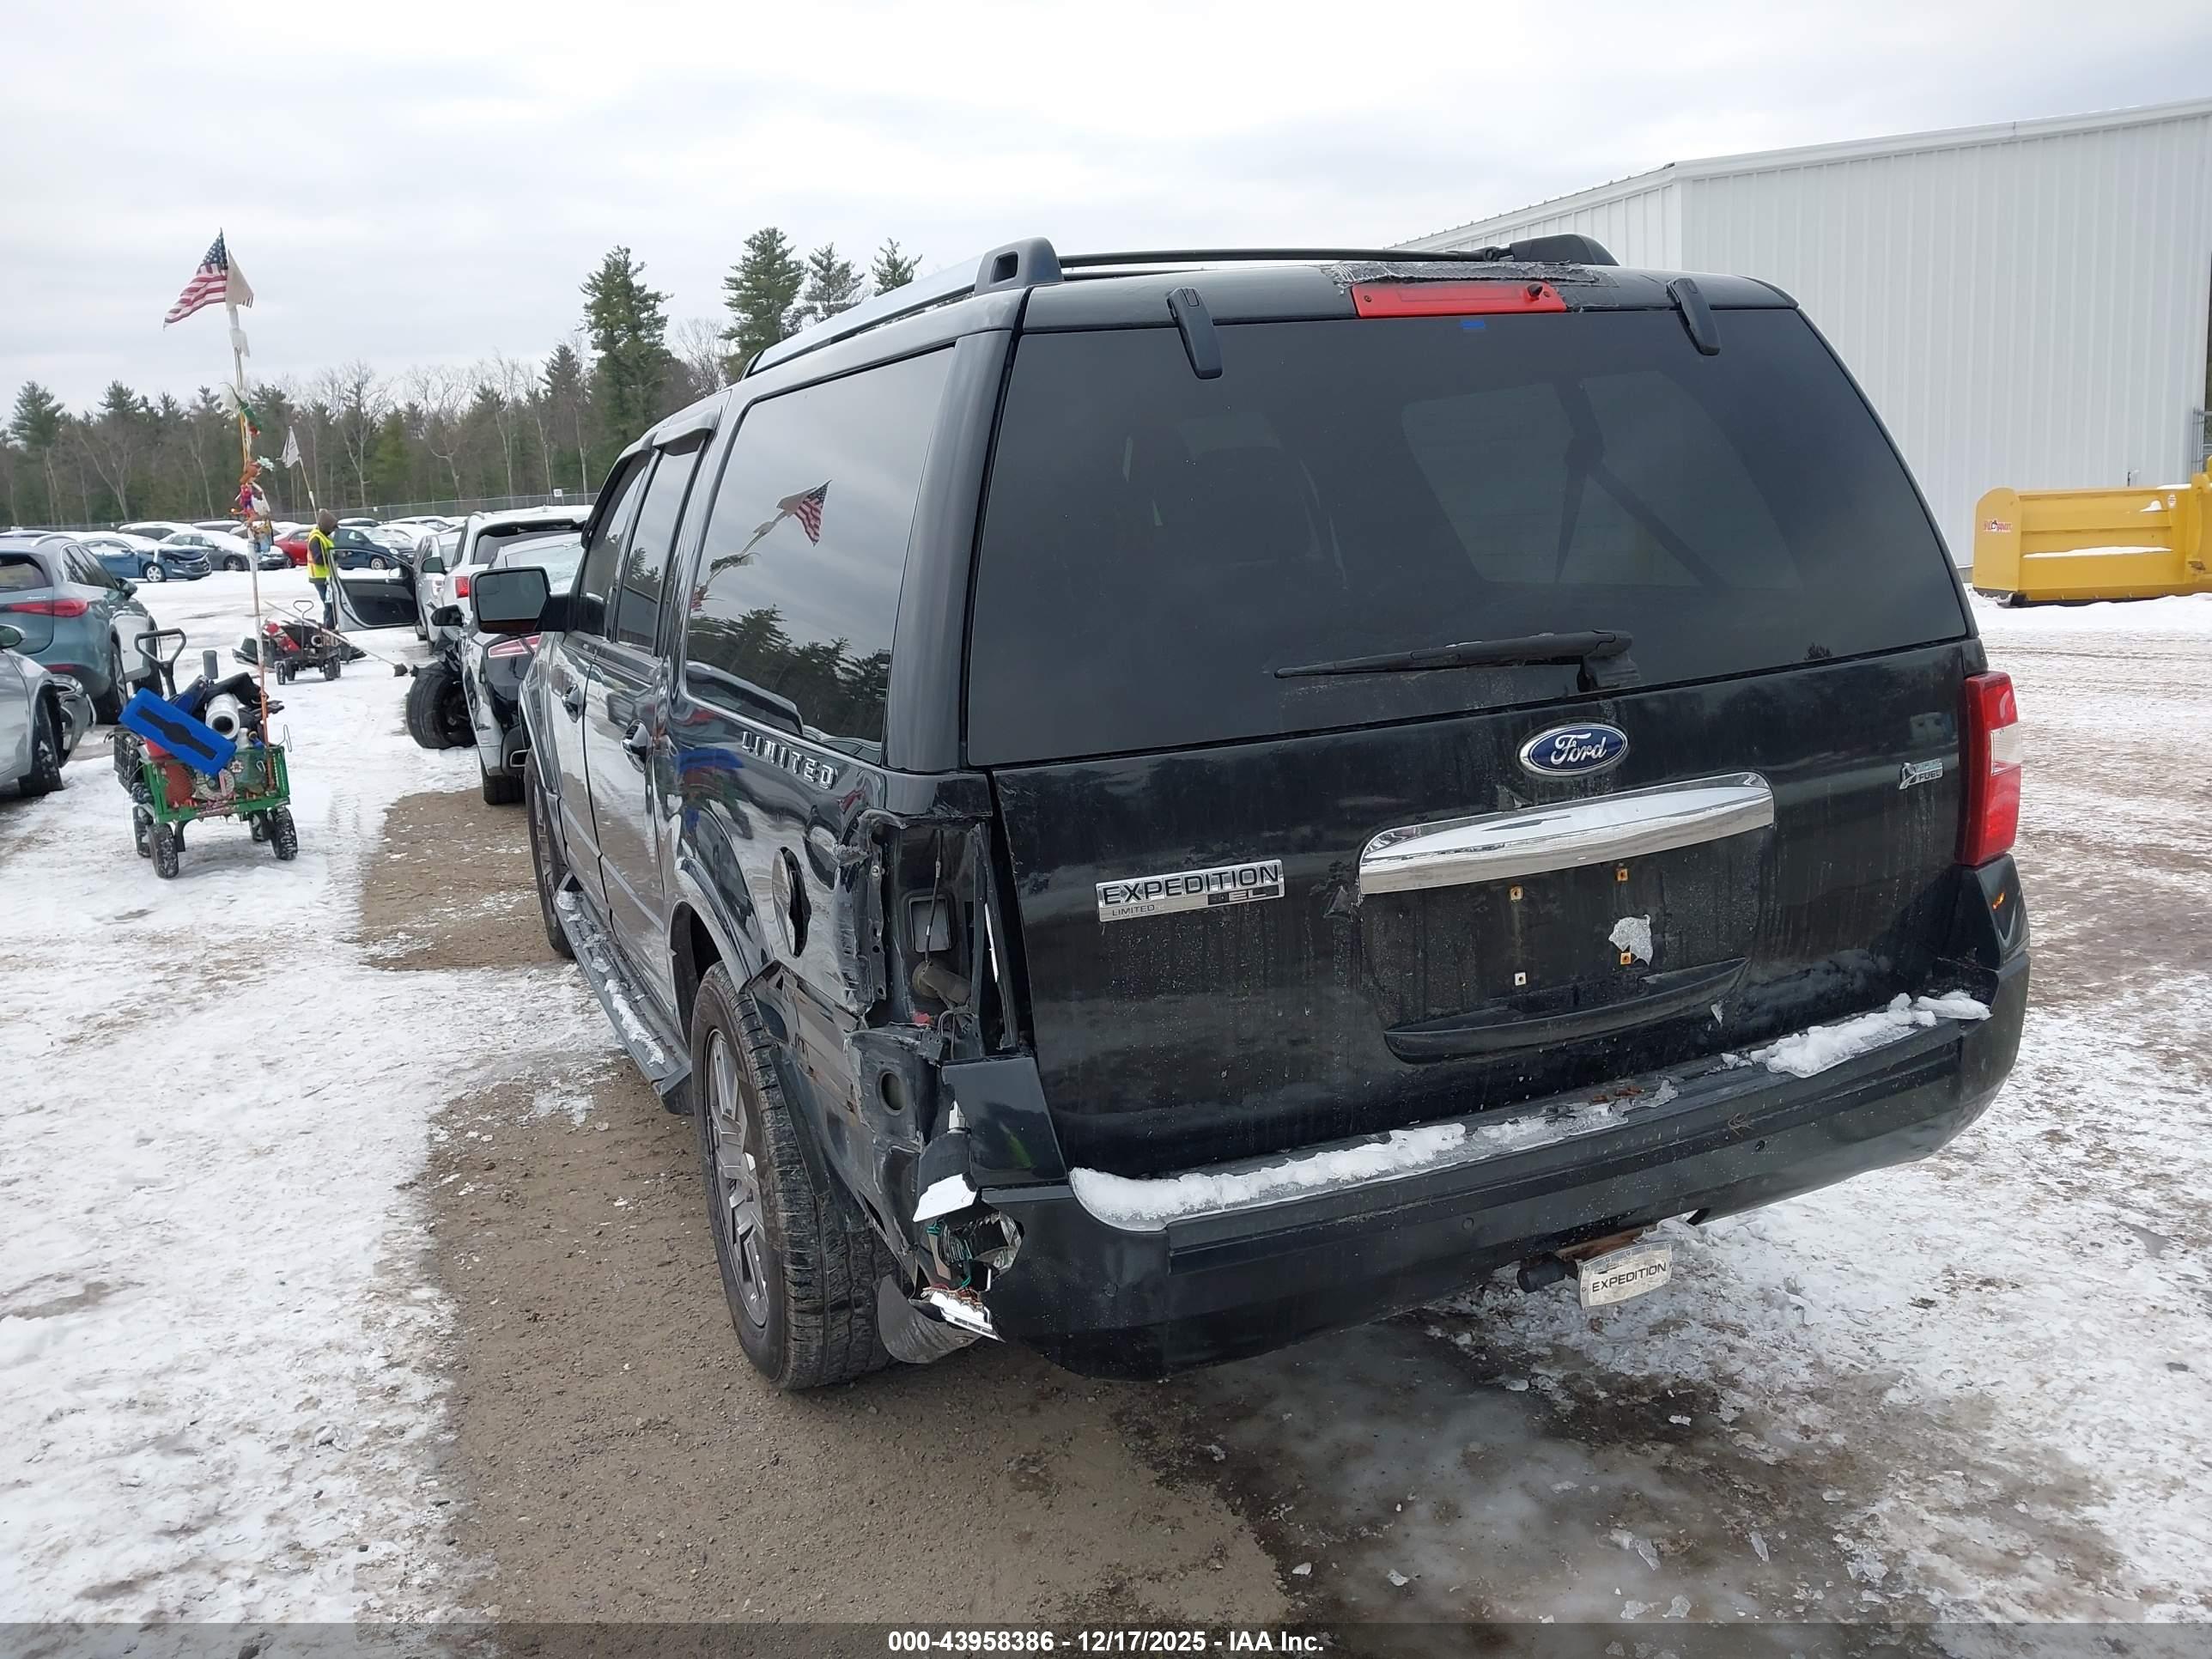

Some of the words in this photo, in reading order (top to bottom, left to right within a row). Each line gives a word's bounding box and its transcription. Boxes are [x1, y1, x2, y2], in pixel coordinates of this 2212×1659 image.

[741, 731, 839, 790] LIMITED
[1550, 732, 1607, 765] Ford
[1918, 769, 1942, 782] FUEL
[1103, 864, 1279, 906] EXPEDITION
[1228, 889, 1267, 902] EL
[1112, 904, 1155, 916] LIMITED
[1592, 1261, 1667, 1292] EXPEDITION
